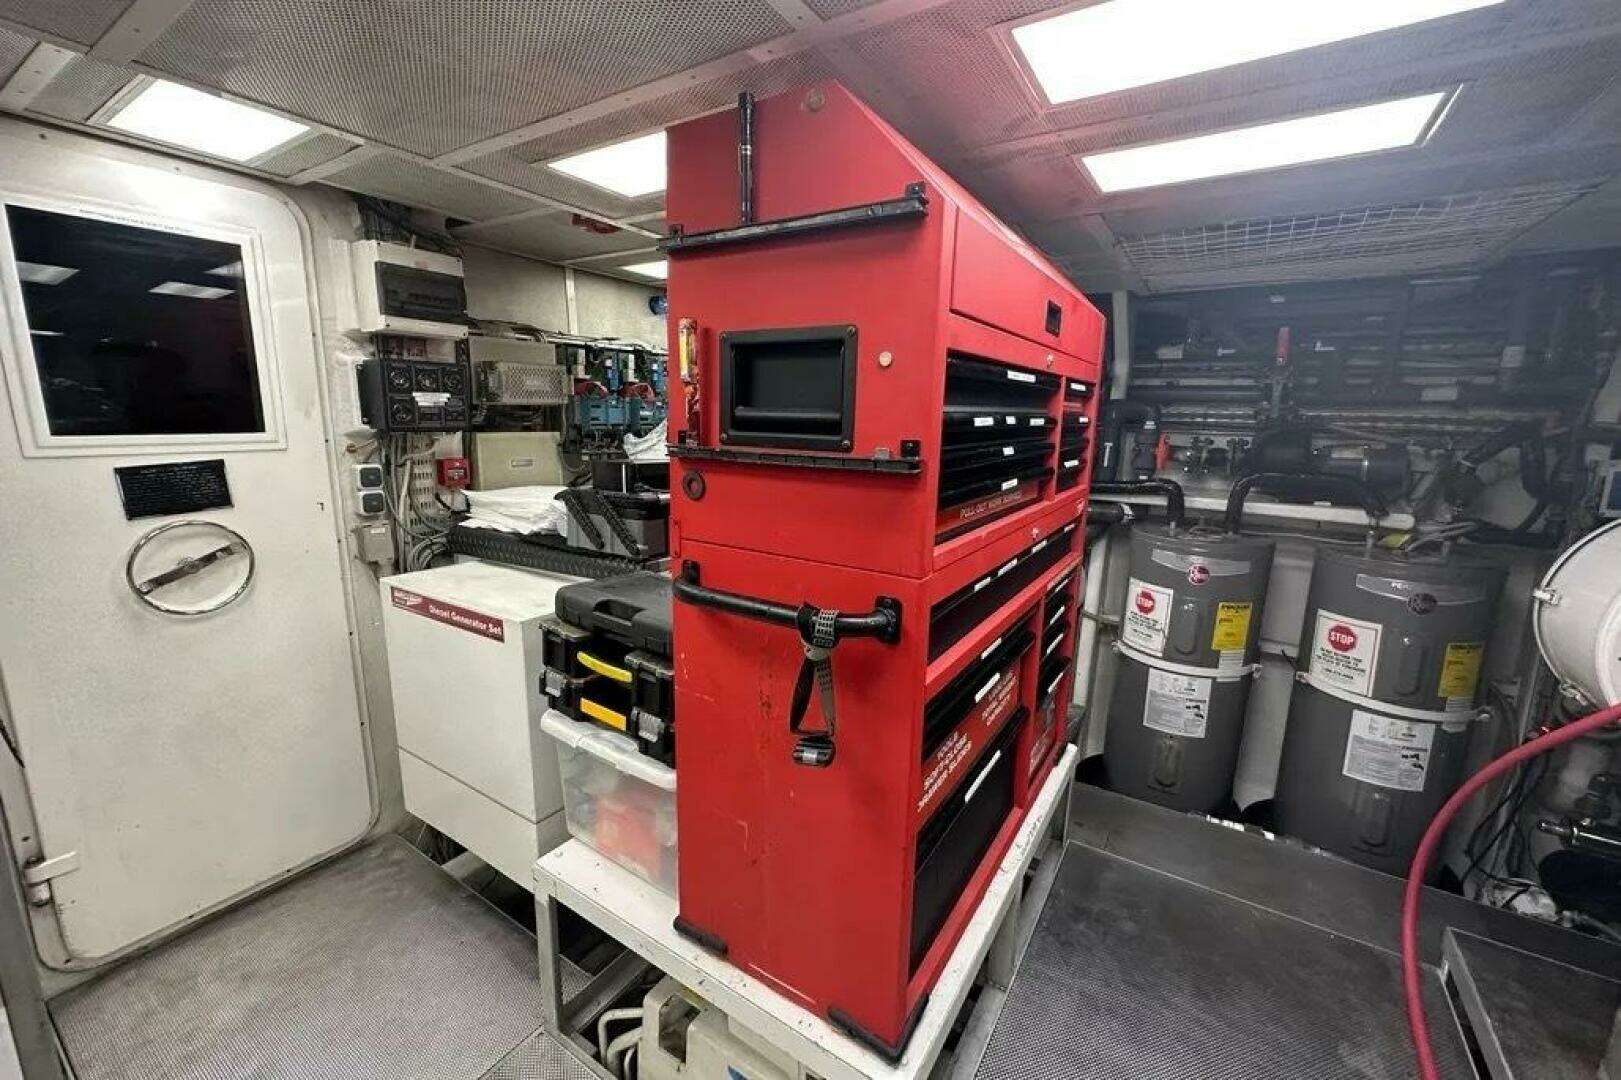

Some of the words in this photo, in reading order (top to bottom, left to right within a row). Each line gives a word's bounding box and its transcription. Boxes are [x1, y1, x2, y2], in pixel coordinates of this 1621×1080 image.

[428, 604, 450, 619] Diesel
[451, 611, 487, 630] Generator
[1329, 632, 1354, 646] STOP
